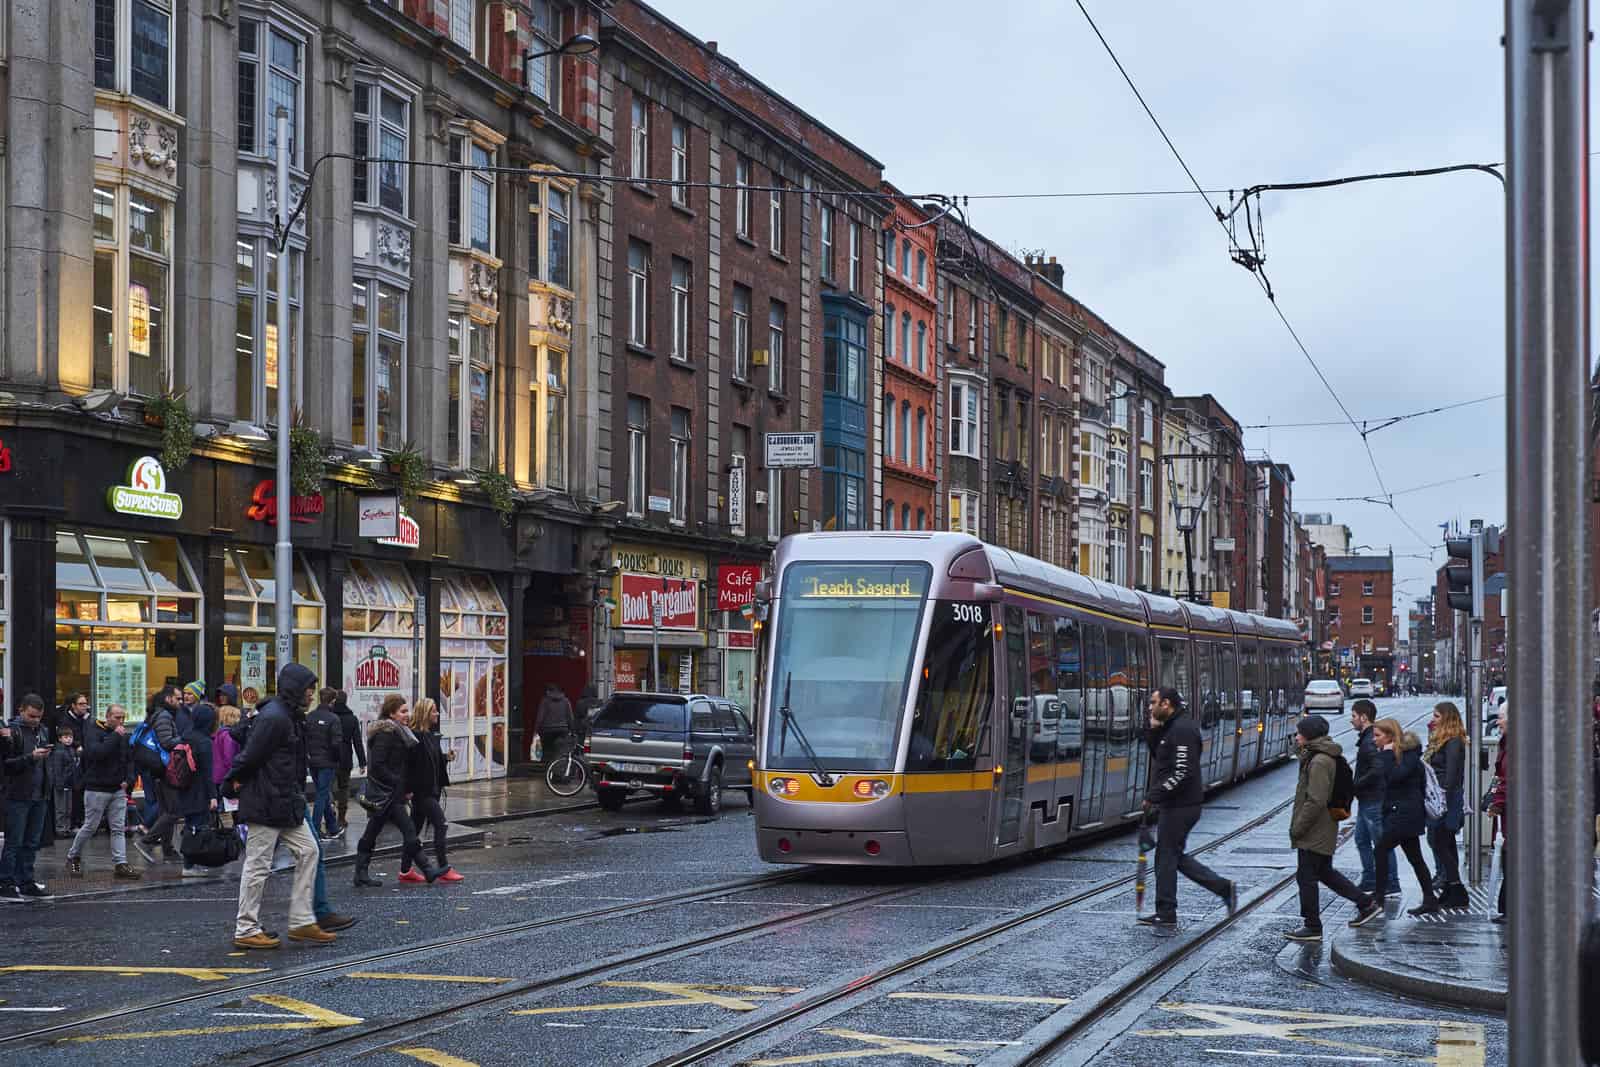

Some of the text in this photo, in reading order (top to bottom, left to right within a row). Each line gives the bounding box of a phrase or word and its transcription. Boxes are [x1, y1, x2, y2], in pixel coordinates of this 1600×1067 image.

[658, 557, 684, 575] OOKS
[726, 570, 753, 585] Café
[811, 577, 910, 595] Teach Sagard
[622, 591, 649, 623] Book
[651, 584, 696, 620] Bargains!
[952, 604, 982, 623] 3018
[356, 659, 375, 687] PAPA
[1161, 745, 1190, 791] HOLLISTER
